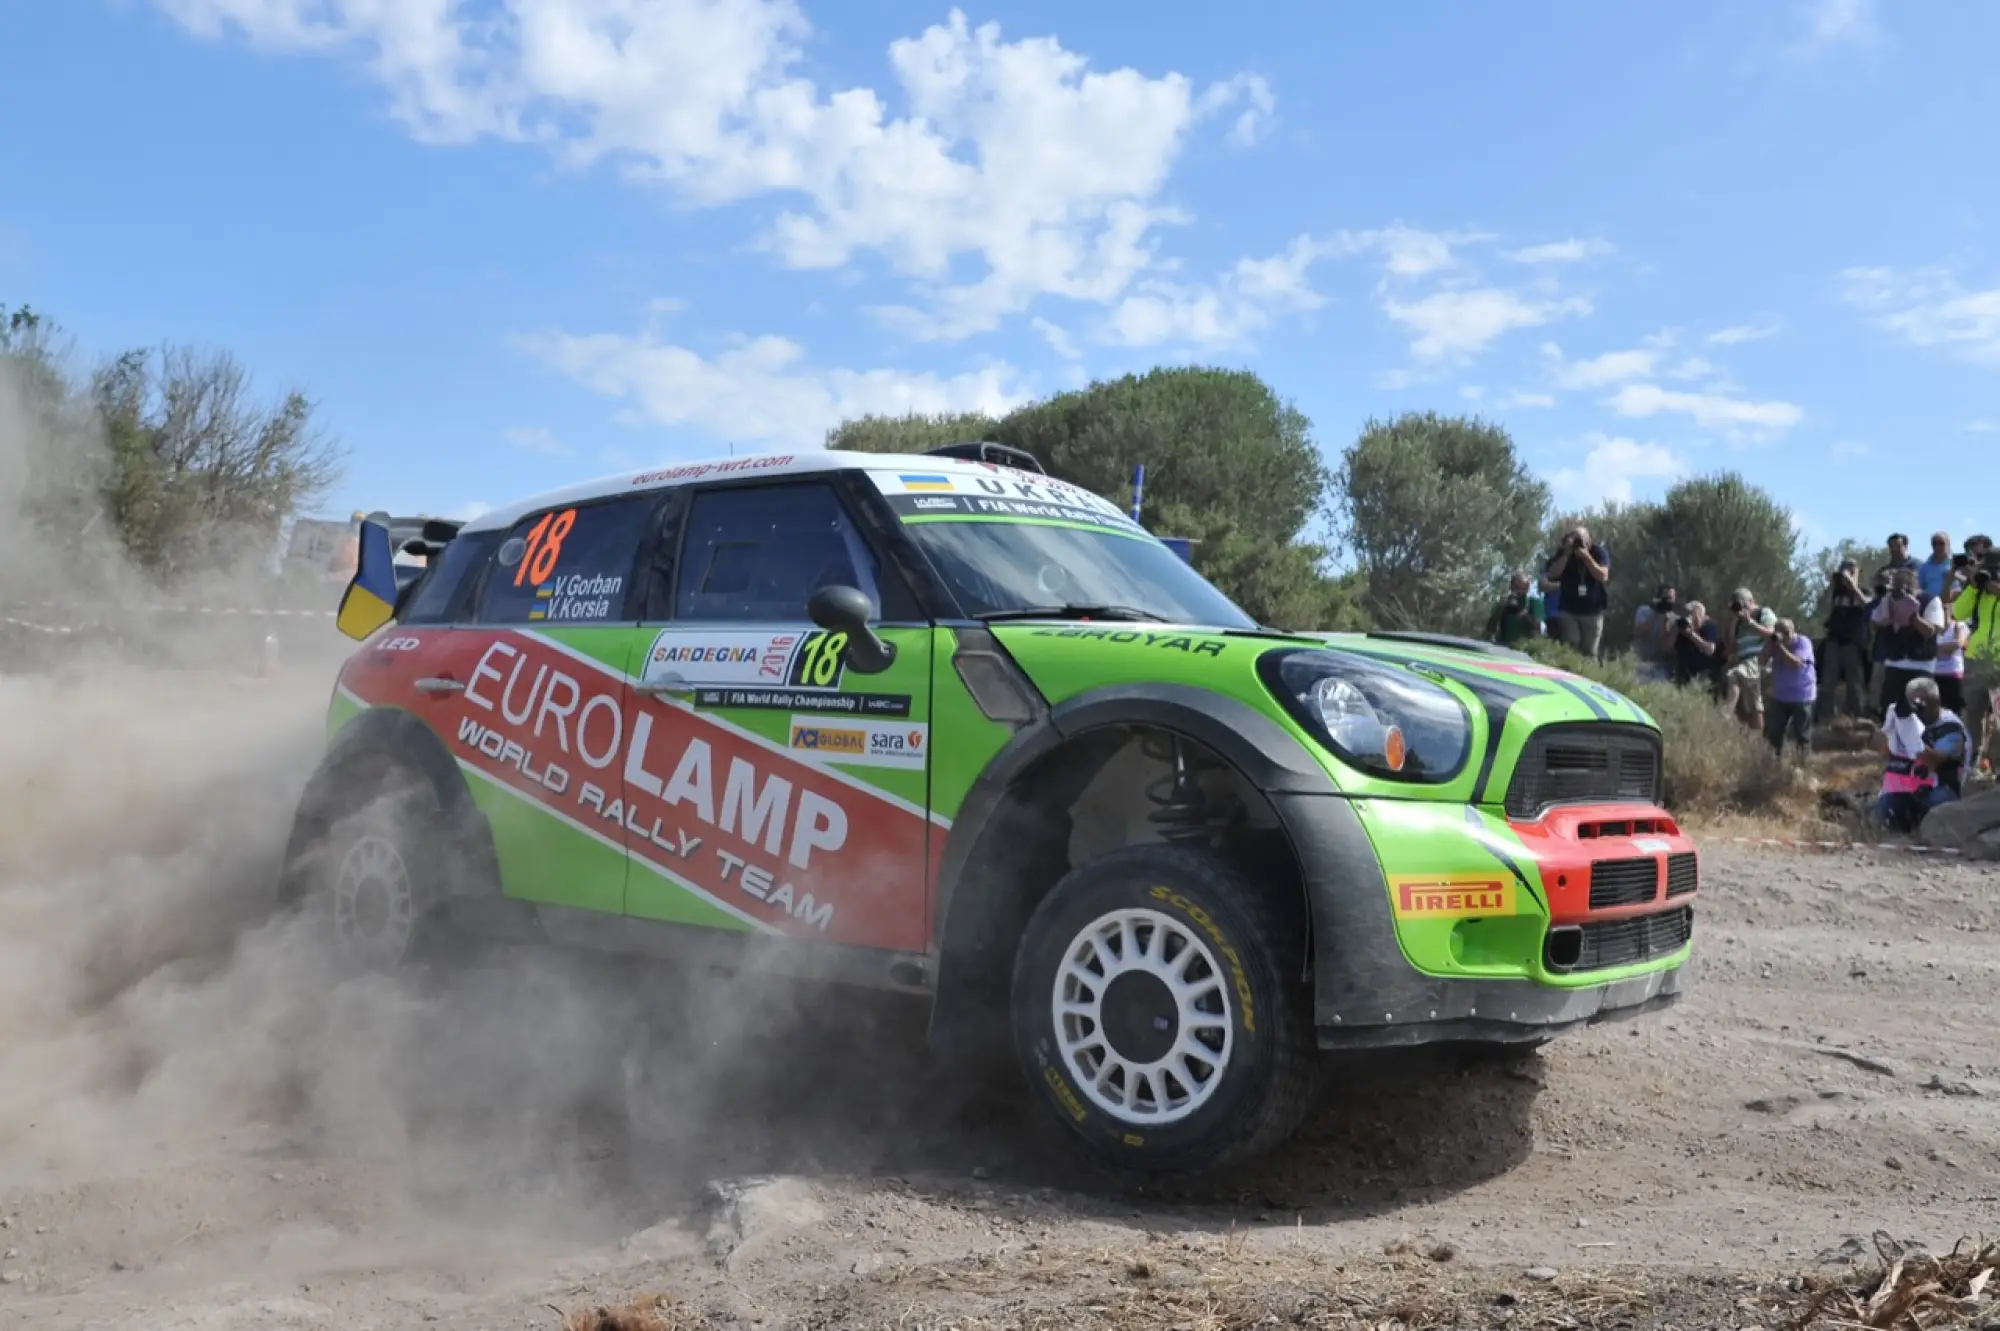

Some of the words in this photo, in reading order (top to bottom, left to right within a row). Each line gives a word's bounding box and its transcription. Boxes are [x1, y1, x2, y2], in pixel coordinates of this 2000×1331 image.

[632, 456, 795, 485] eurolamp-wrt.com
[978, 499, 1012, 513] FIA
[514, 508, 577, 587] 18
[654, 647, 757, 663] SARDEGNA
[759, 636, 794, 677] 2016
[801, 632, 848, 686] 18
[730, 691, 746, 704] FIA
[747, 692, 771, 705] World
[772, 694, 794, 709] Rally
[794, 694, 856, 710] Championship
[463, 640, 849, 871] EUROLAMP
[820, 733, 864, 749] GLOBAL
[871, 733, 904, 749] sara
[457, 716, 570, 794] WORLD
[578, 780, 703, 859] RALLY
[716, 848, 835, 931] TEAM
[1399, 881, 1504, 911] PIRELLI
[1149, 886, 1256, 1033] SCORPION
